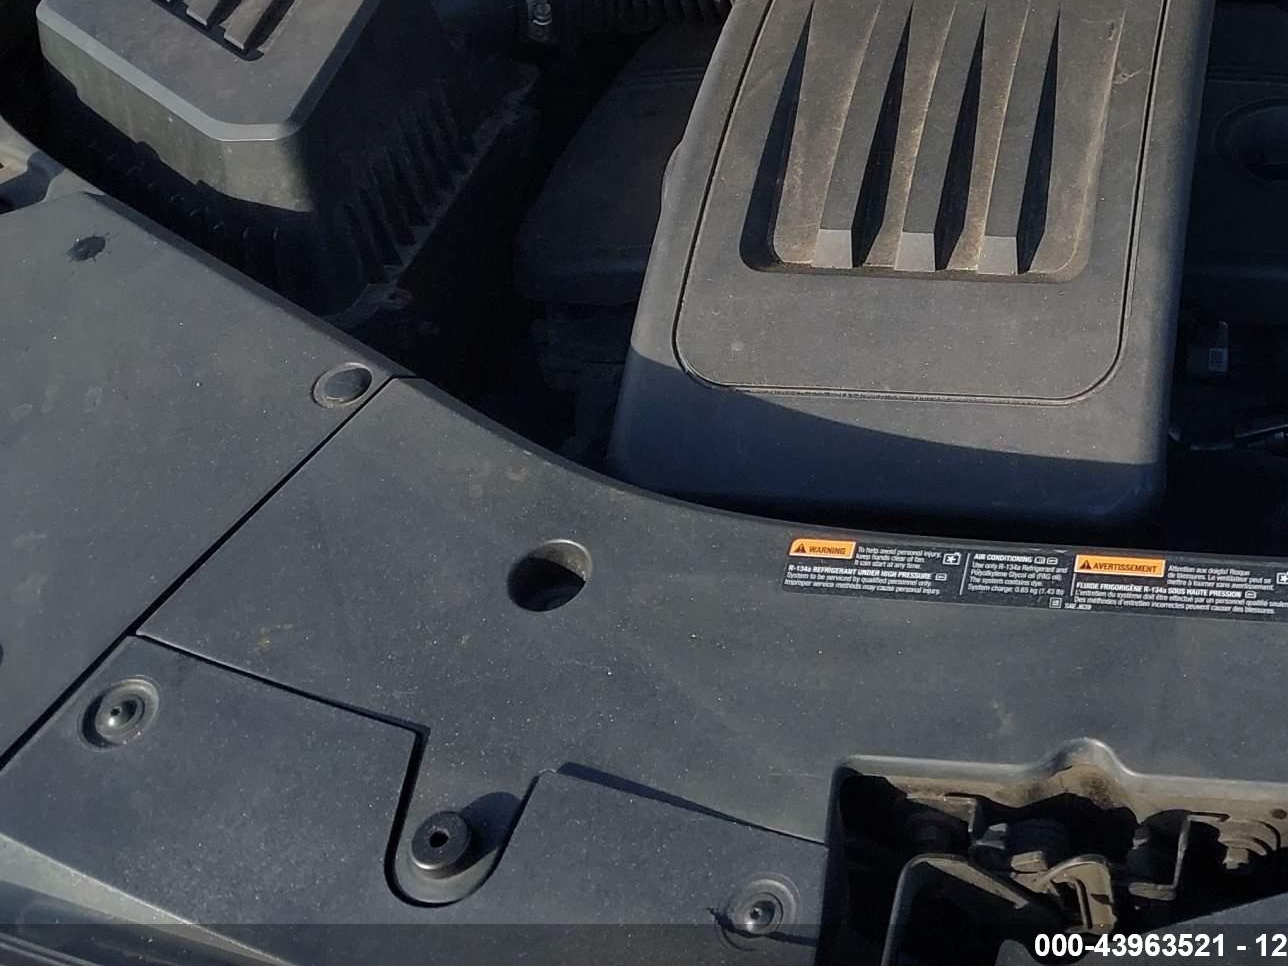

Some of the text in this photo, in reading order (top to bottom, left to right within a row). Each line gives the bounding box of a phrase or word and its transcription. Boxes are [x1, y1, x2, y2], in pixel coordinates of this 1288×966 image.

[809, 545, 846, 555] WARNING
[896, 548, 923, 557] personal
[986, 553, 1033, 563] CONDITIONING
[984, 562, 997, 570] only
[998, 563, 1021, 571] R-134a
[1092, 562, 1157, 572] AVERTISSEMENT
[786, 572, 809, 580] System
[788, 564, 931, 579] R-134a REFRIGERANT UNDER HIGH PRESSURE
[981, 577, 1003, 585] system
[894, 585, 922, 593] personal
[967, 583, 990, 592] System
[1076, 582, 1099, 590] FLUIDE
[1143, 585, 1167, 594] R-134a
[1167, 586, 1186, 595] SOUS
[1186, 587, 1209, 596] HAUTE
[1208, 588, 1242, 597] PRESSION
[1214, 596, 1245, 606] personnel
